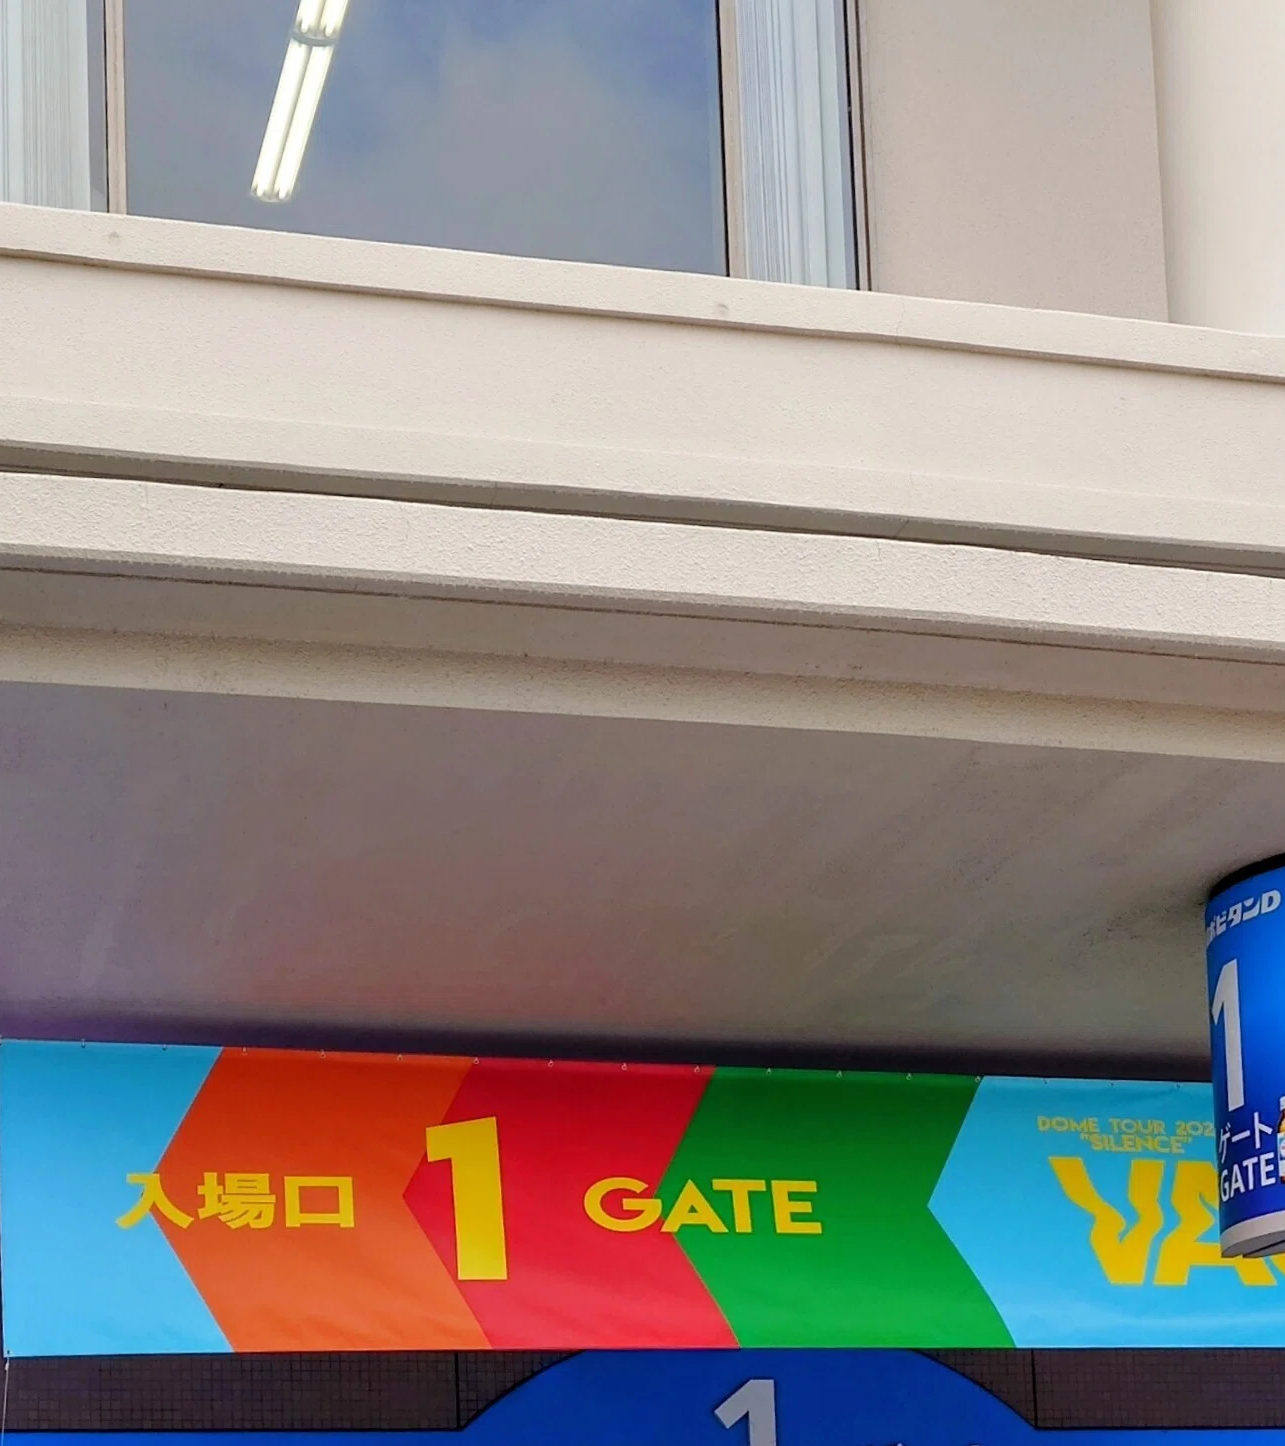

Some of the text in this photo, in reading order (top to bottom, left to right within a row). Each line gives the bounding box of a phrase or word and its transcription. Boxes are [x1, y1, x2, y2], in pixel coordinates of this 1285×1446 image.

[1211, 958, 1244, 1112] 1
[1037, 1115, 1214, 1137] DOME TOUR 202
[1218, 1111, 1272, 1163] ゲート
[114, 1115, 823, 1281] 入場口 1 GATE
[1220, 1152, 1276, 1201] GATE
